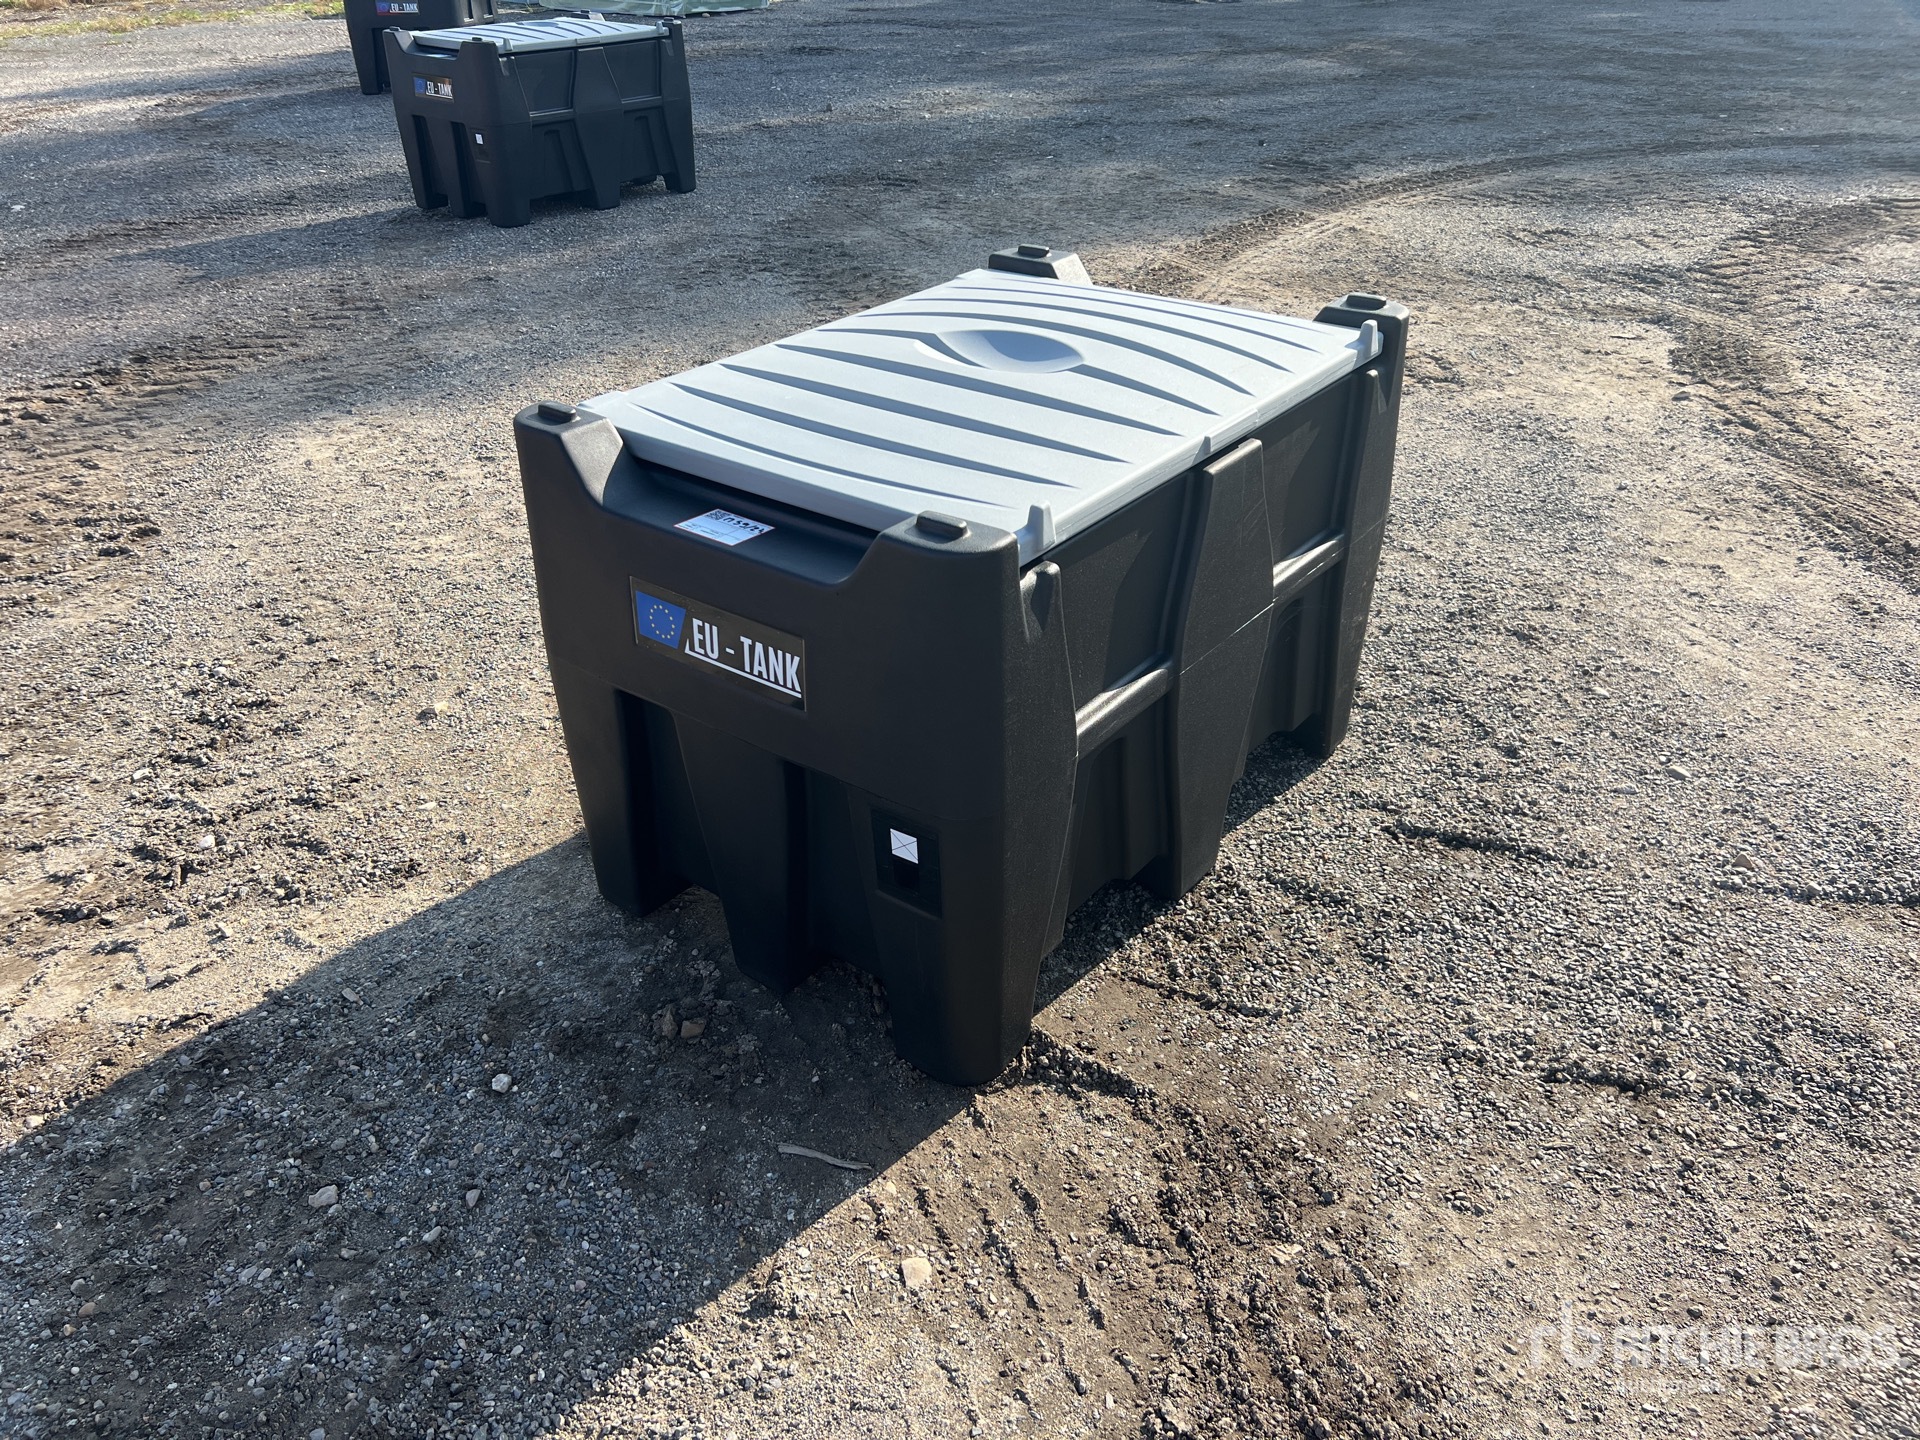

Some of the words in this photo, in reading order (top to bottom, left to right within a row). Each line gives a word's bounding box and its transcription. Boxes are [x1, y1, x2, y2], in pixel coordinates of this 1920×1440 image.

[391, 3, 399, 12] EU
[403, 3, 418, 12] TANK
[427, 81, 435, 94] EU
[438, 83, 453, 97] TANK
[692, 617, 720, 660] EU
[739, 635, 802, 692] TANK
